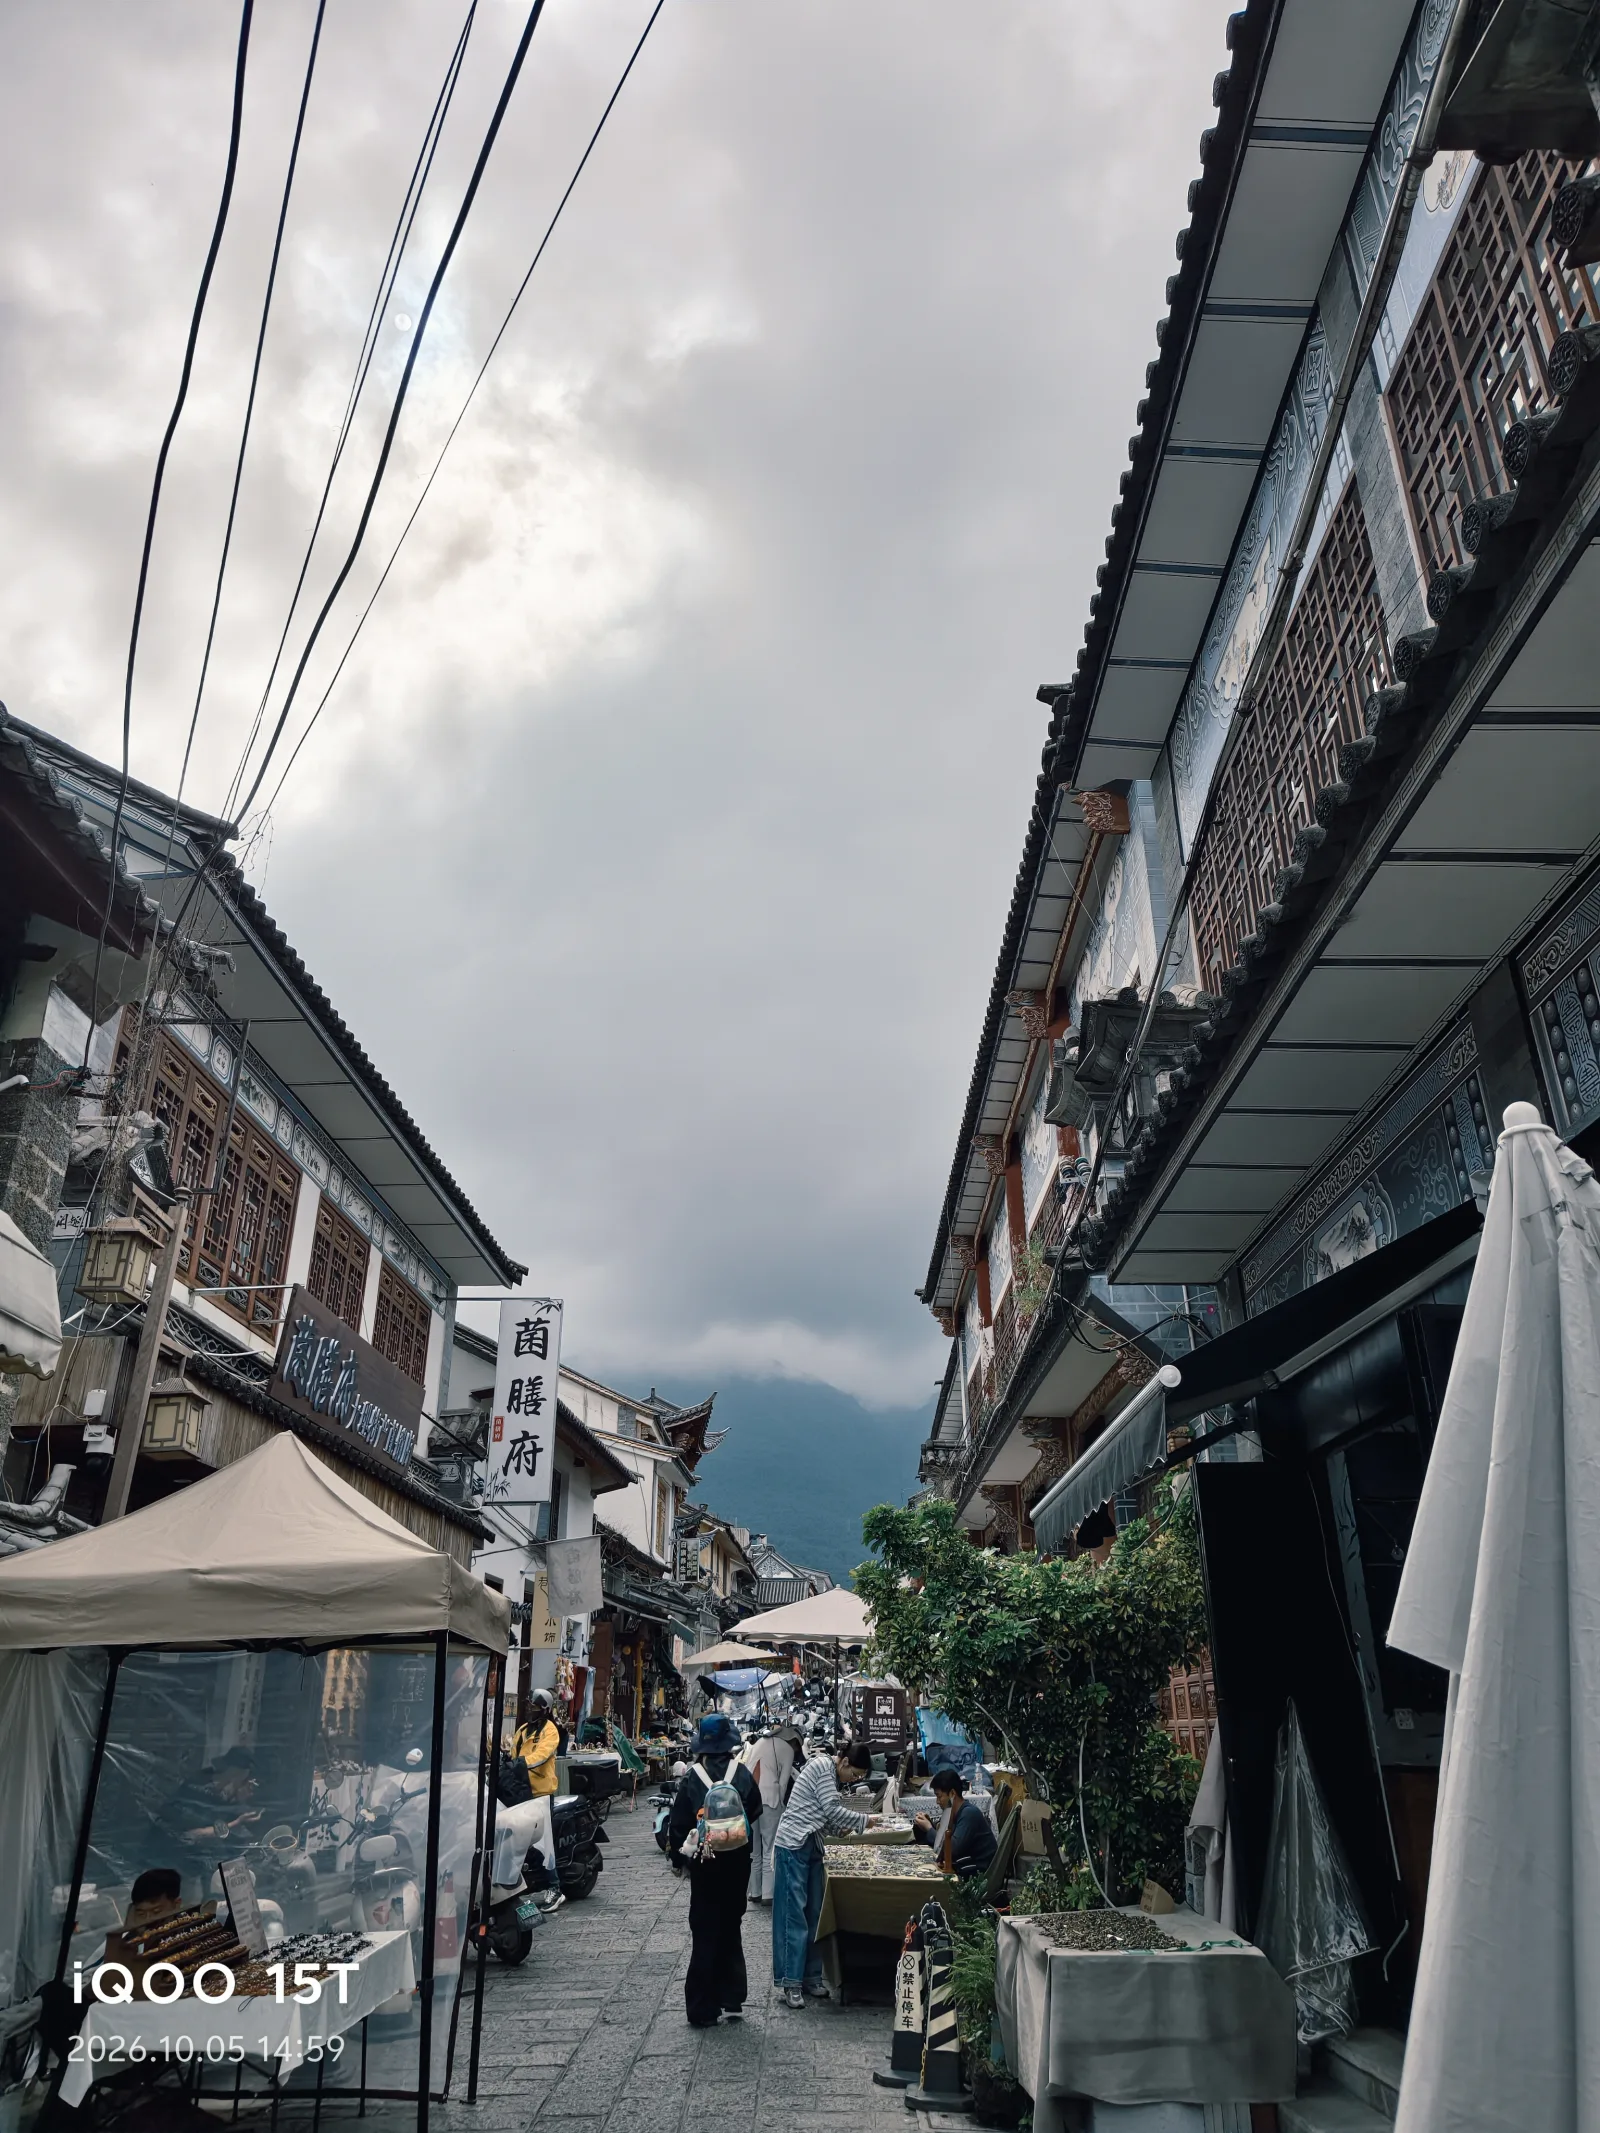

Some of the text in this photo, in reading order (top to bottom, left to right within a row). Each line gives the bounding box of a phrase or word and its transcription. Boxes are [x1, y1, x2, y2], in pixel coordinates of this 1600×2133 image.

[502, 1317, 551, 1477] 菌膳府
[902, 1971, 915, 2029] 禁止停车
